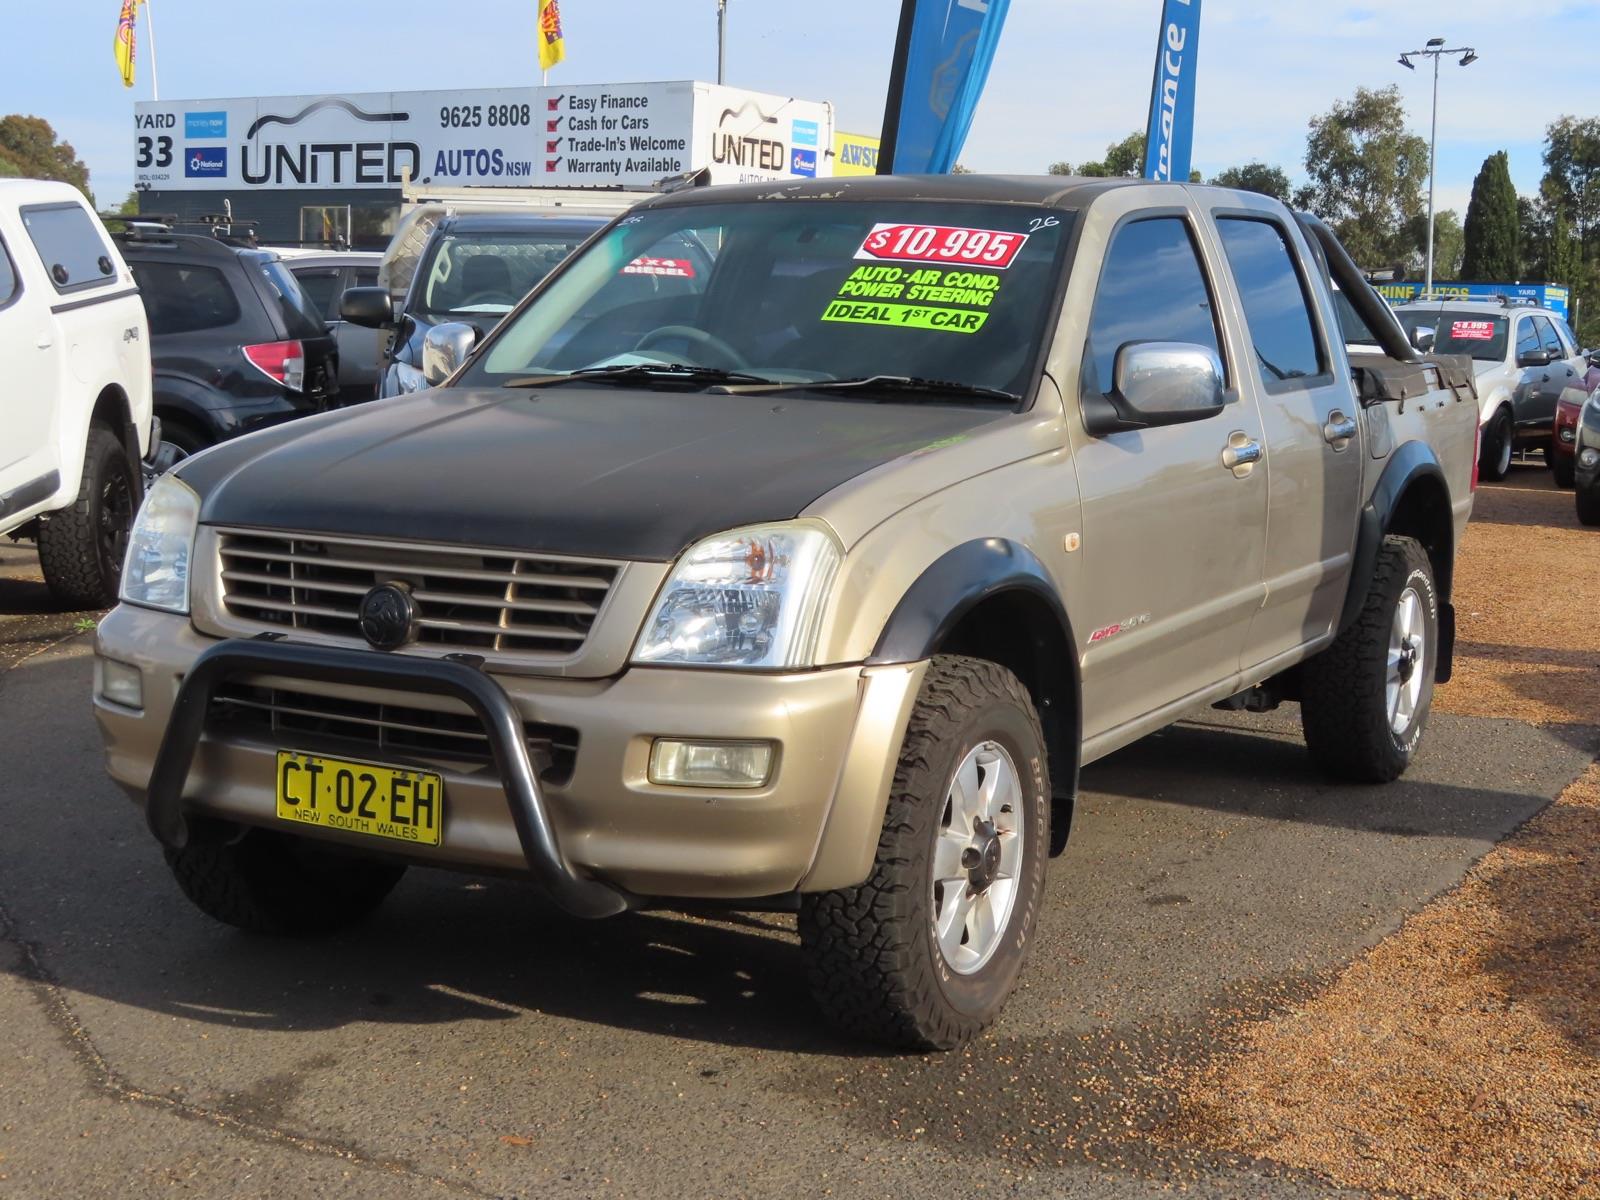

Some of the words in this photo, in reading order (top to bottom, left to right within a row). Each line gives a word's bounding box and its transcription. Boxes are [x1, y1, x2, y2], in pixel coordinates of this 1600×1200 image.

[569, 95, 597, 113] Easy
[601, 94, 648, 109] Finance
[135, 113, 176, 129] YARD
[440, 105, 482, 128] 9625
[488, 104, 530, 127] 8808
[568, 116, 597, 131] Cash
[601, 115, 617, 130] for
[621, 114, 649, 130] Cars
[136, 135, 173, 168] 33
[568, 137, 626, 152] Trade-In's
[630, 136, 686, 151] Welcome
[200, 160, 223, 168] National
[241, 141, 421, 184] UNITED
[434, 148, 504, 177] AUTOS
[506, 161, 531, 176] NSW
[567, 158, 621, 176] Warranty
[625, 157, 681, 172] Available
[1029, 216, 1060, 233] 26
[624, 266, 689, 276] DIESEL
[943, 271, 1000, 291] COND.
[838, 280, 904, 298] POWER
[906, 284, 994, 306] STEERING
[827, 304, 891, 322] IDEAL
[930, 311, 980, 330] CAR
[294, 809, 320, 823] NEW
[328, 814, 369, 832] SOUTH
[377, 823, 418, 840] WALES
